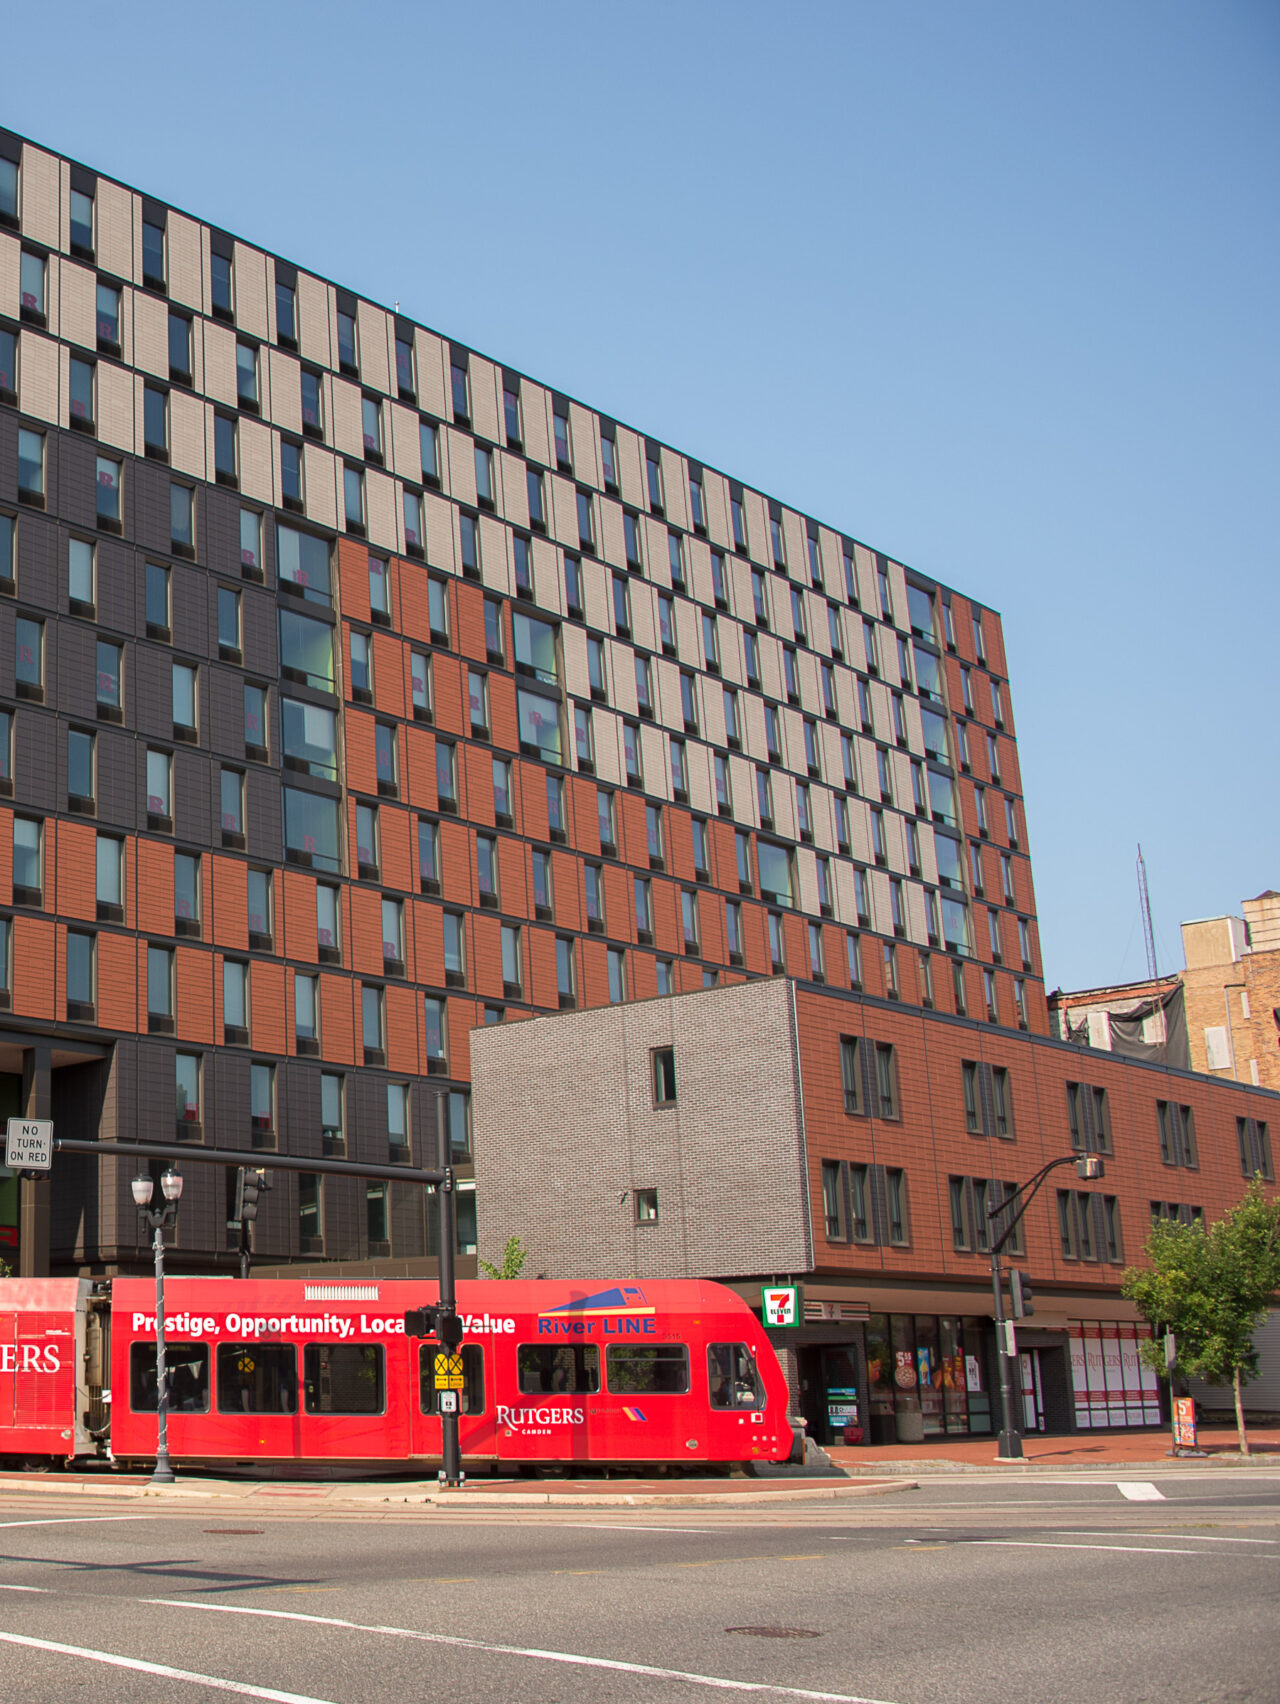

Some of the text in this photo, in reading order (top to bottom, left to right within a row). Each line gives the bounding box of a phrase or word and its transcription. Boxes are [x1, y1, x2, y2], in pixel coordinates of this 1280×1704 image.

[22, 1125, 39, 1136] NO
[17, 1138, 43, 1149] TURN
[10, 1151, 47, 1162] ON RED
[770, 1293, 790, 1323] 7
[225, 1313, 355, 1338] Opportunity,
[538, 1318, 657, 1334] River LINE
[496, 1405, 584, 1432] RUTGERS
